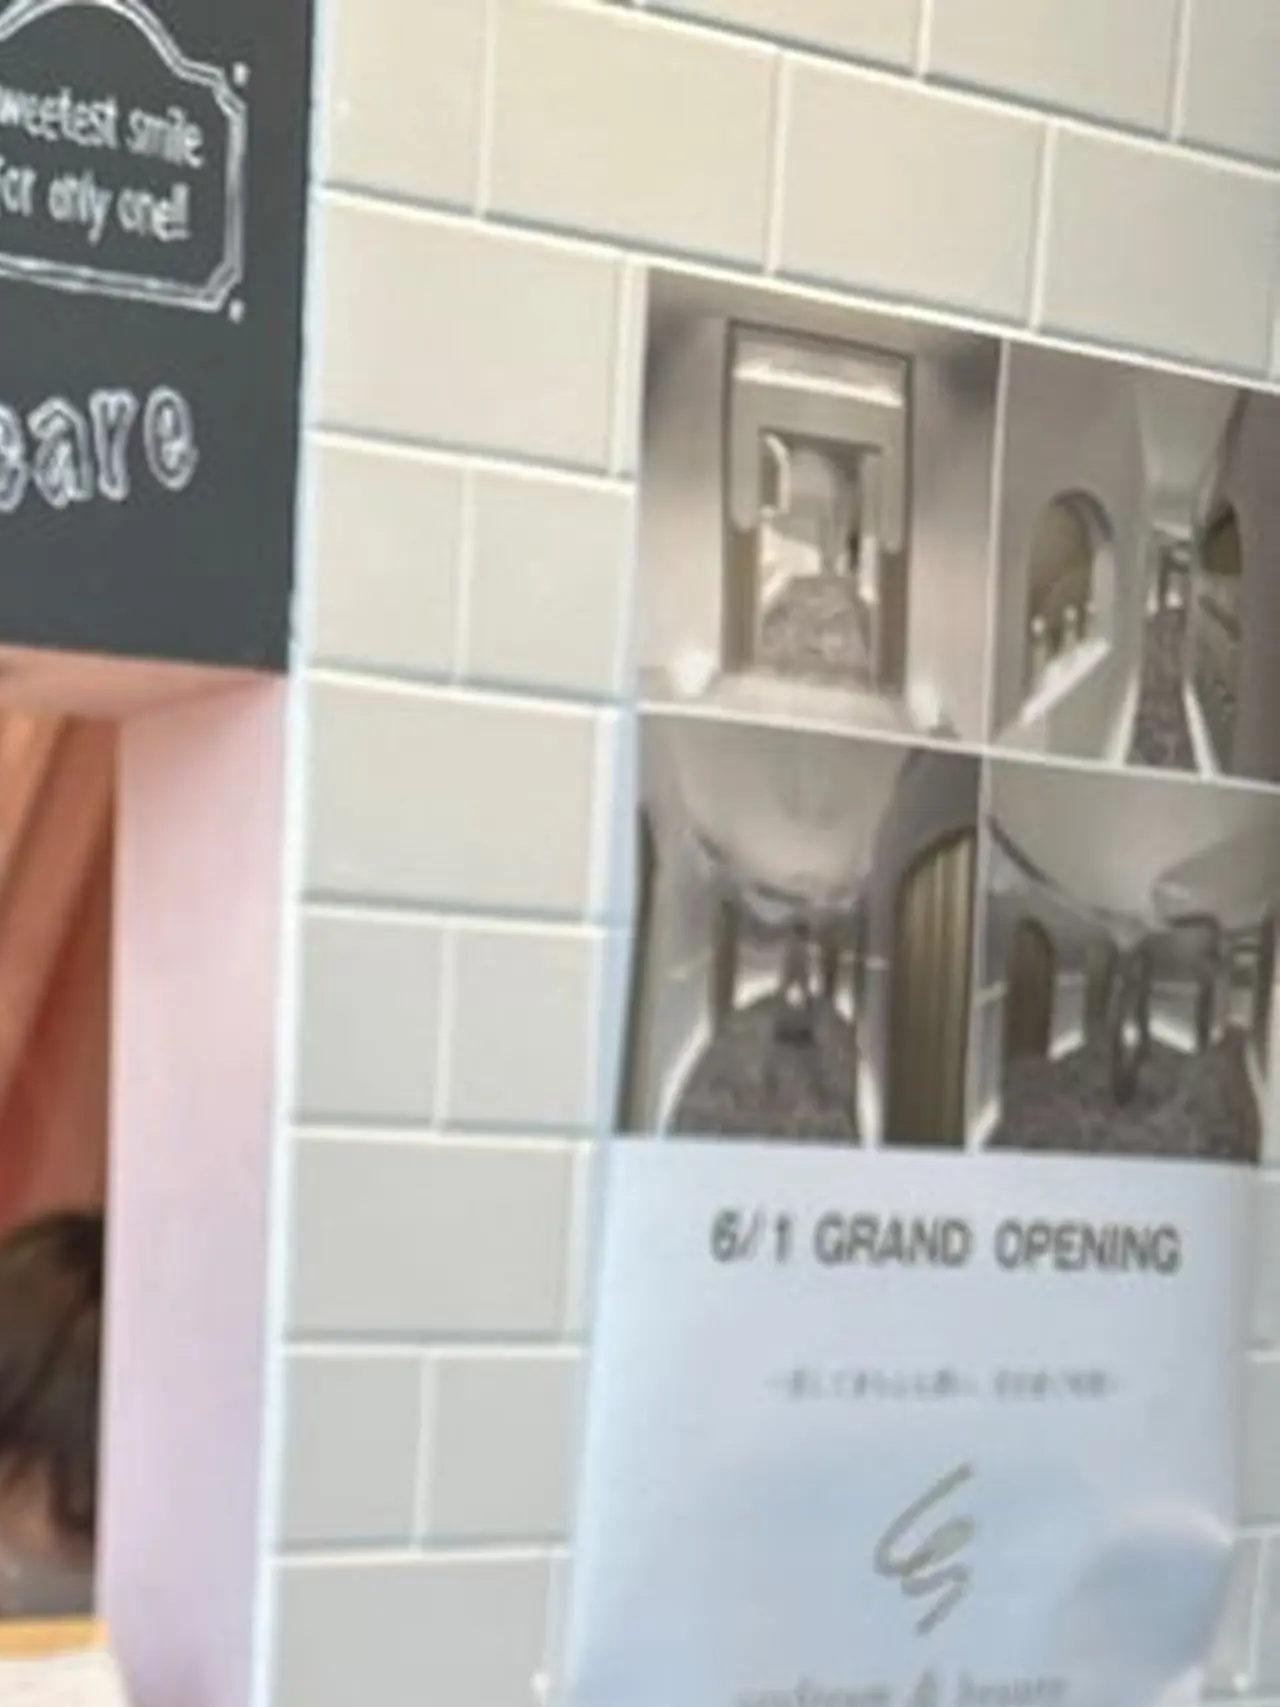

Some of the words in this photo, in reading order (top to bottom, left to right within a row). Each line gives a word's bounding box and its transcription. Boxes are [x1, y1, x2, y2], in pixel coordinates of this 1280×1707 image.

[711, 1208, 796, 1264] 6/1
[815, 1211, 973, 1269] GRAND
[993, 1218, 1182, 1275] OPENING
